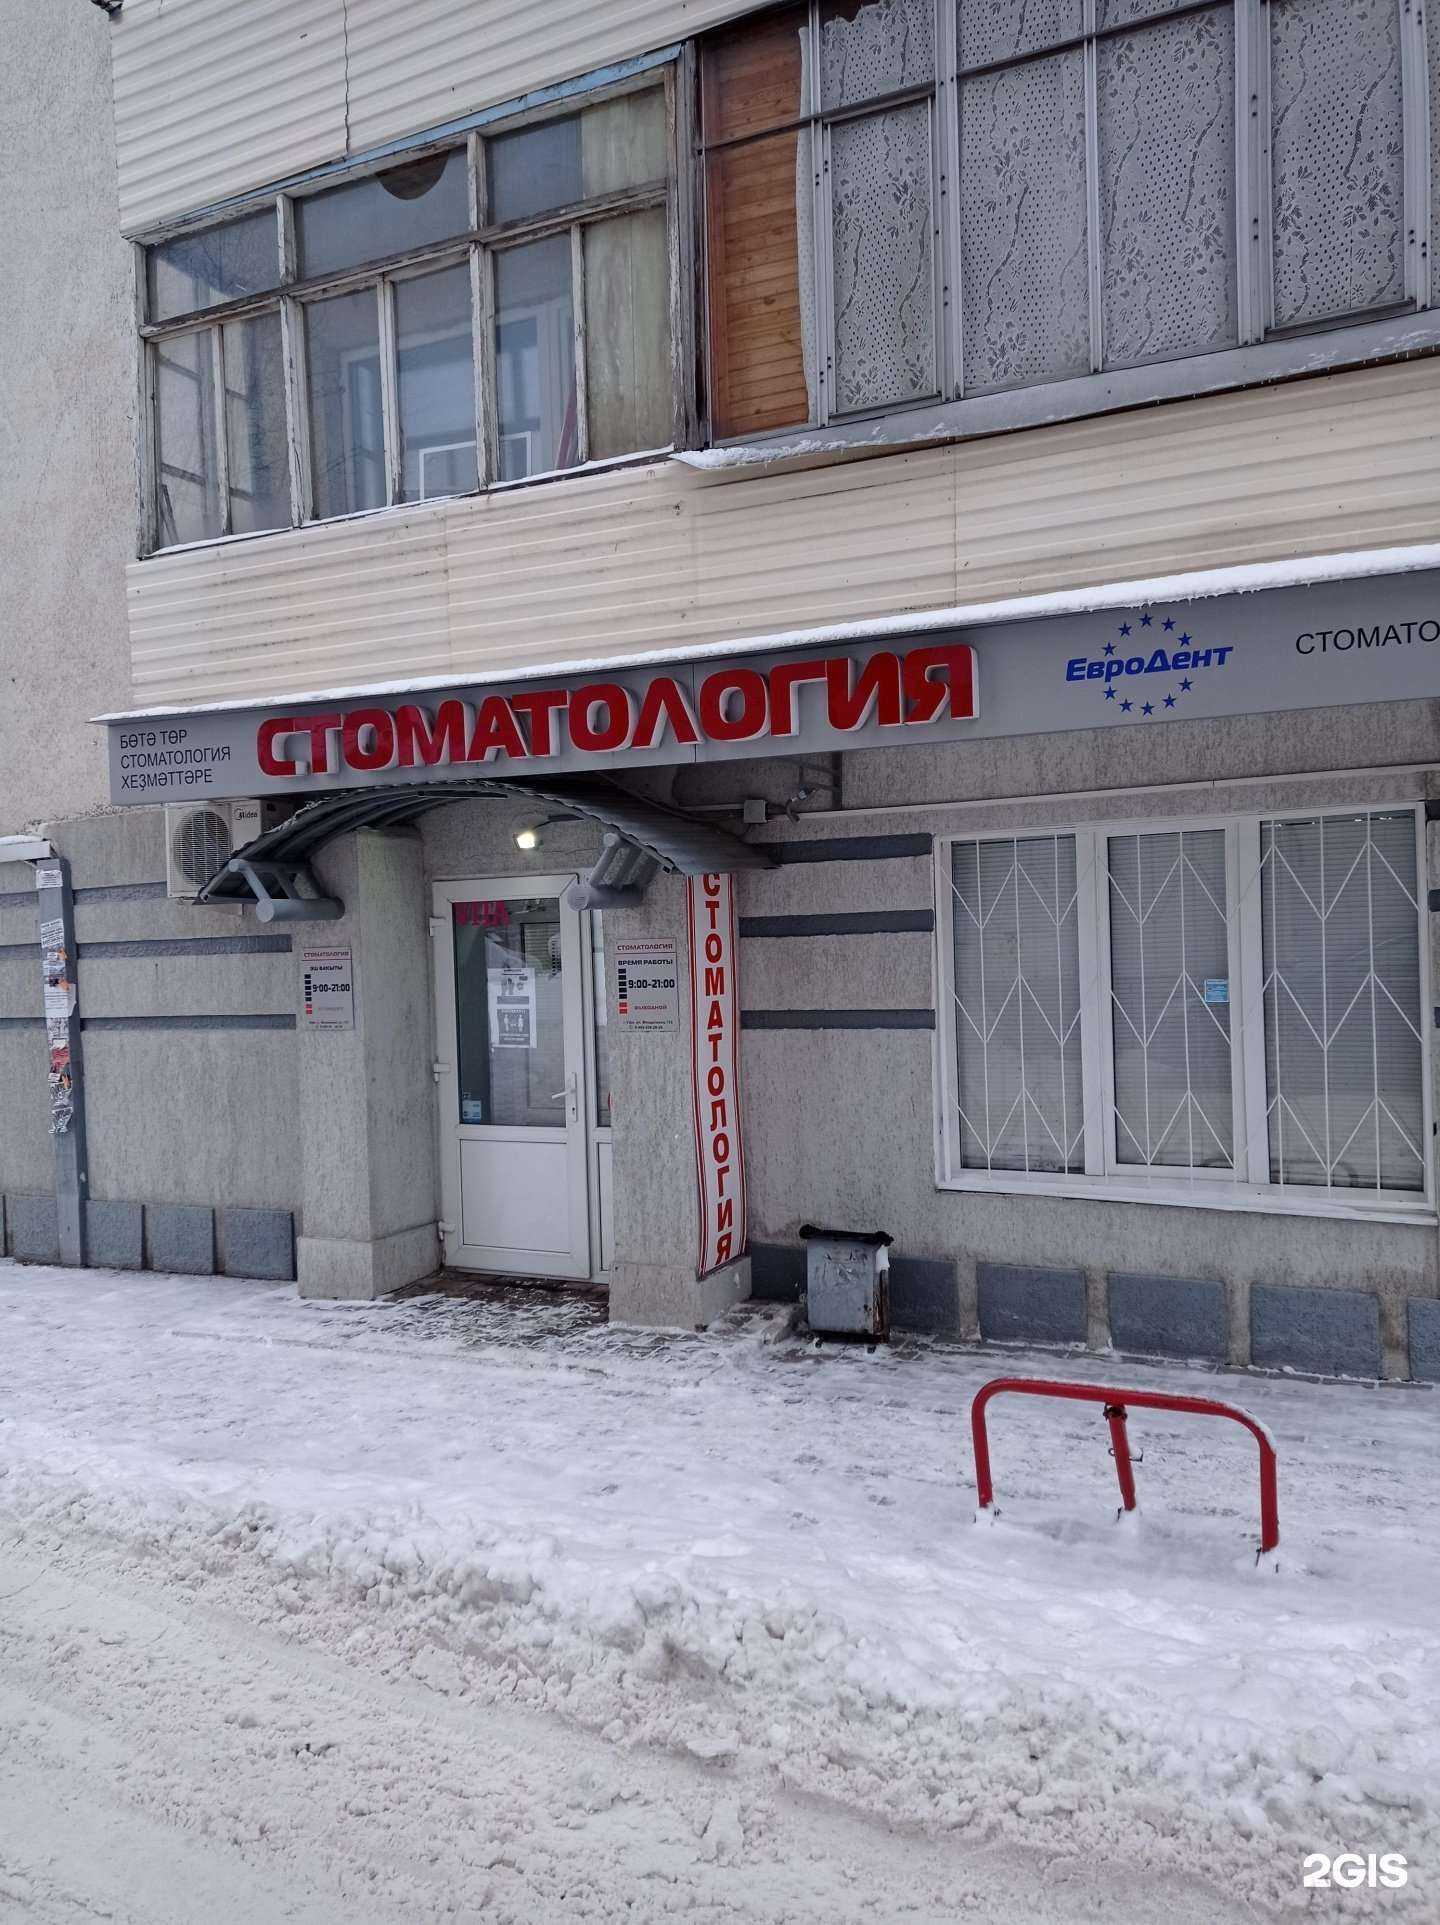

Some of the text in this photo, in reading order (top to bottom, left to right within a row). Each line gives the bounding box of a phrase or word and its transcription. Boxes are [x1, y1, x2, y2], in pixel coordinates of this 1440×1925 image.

[1295, 620, 1440, 655] СТОМАТО
[1065, 646, 1234, 683] ЕвроДент
[256, 644, 979, 777] СТОМАТОЛОГИЯ
[160, 729, 187, 745] ТӨР
[120, 746, 231, 769] СТОМАТОЛОГИЯ
[617, 943, 673, 951] СТОМАТОЛОГИЯ
[312, 983, 350, 993] 9:00-21:00
[628, 979, 675, 989] 9:00-21:00
[702, 873, 733, 1265] СТОМАТОЛОГИЯ
